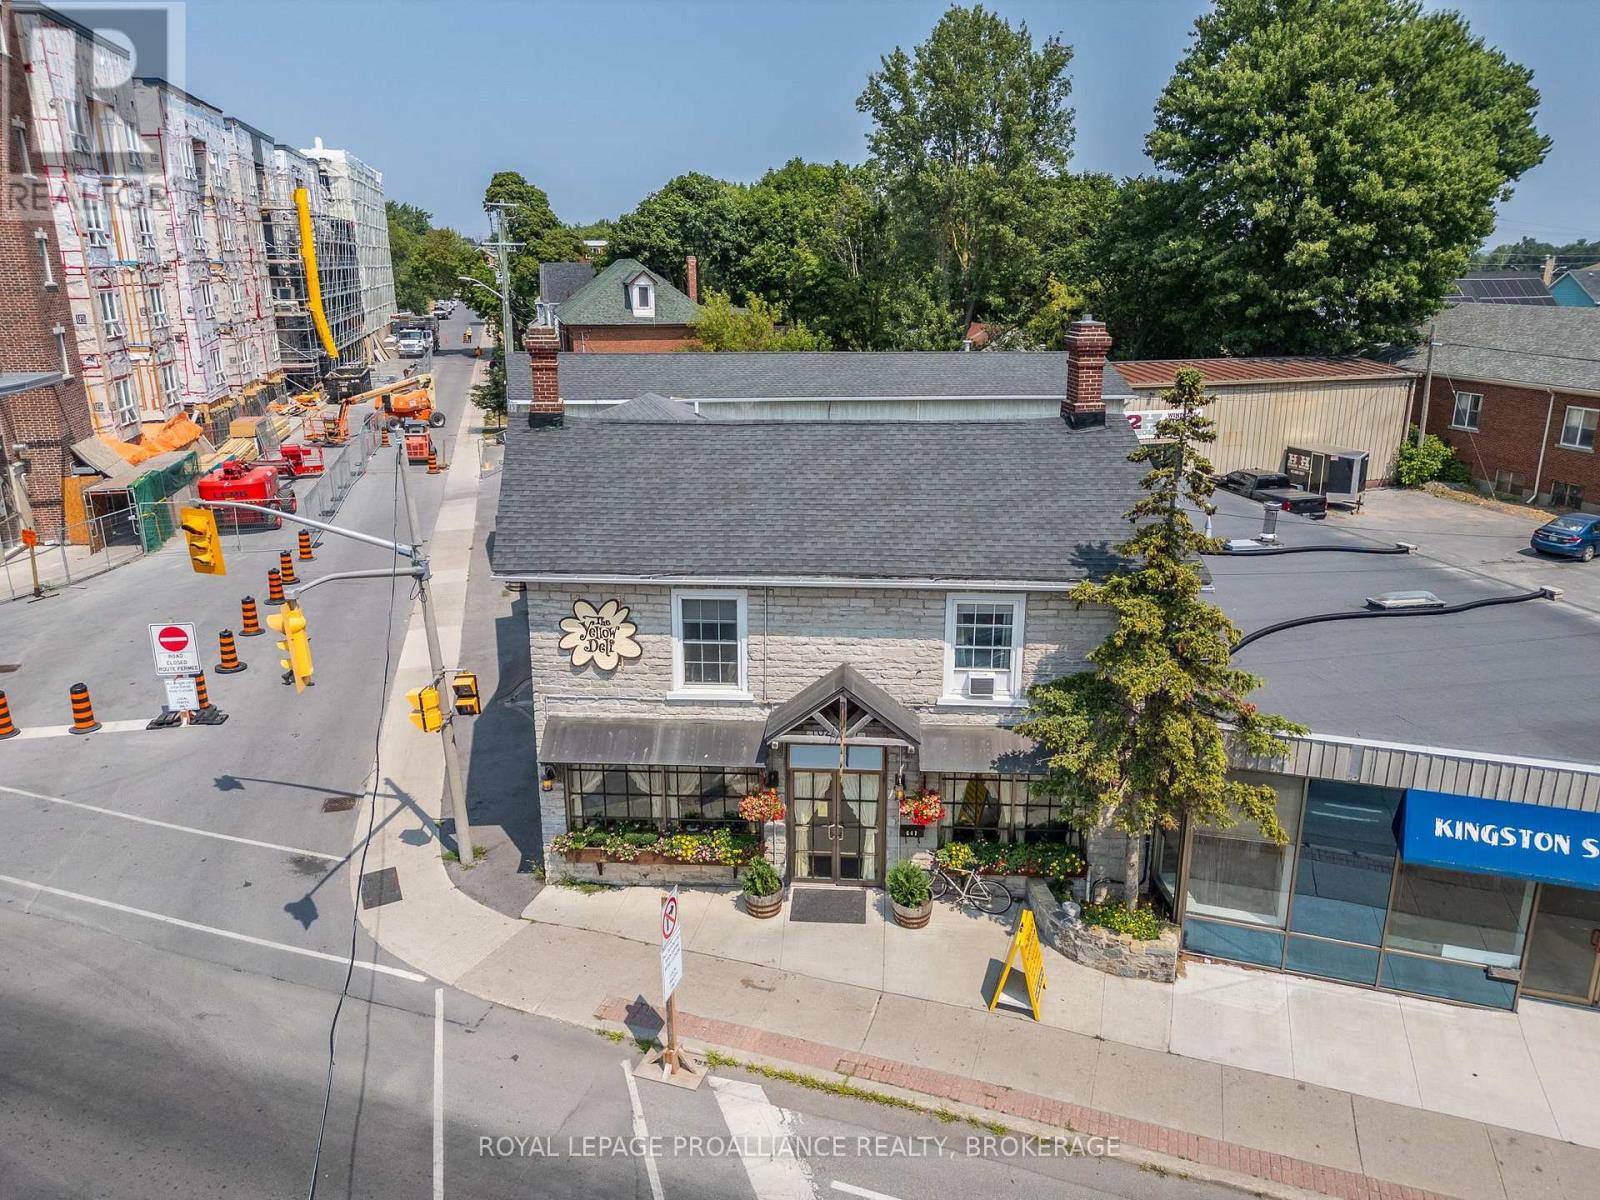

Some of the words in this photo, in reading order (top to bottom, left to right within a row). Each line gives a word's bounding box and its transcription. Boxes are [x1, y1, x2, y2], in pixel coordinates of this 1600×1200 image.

[583, 615, 611, 626] The
[579, 621, 620, 640] Yellow
[584, 639, 615, 657] Deli
[1434, 817, 1571, 855] KINGSTON
